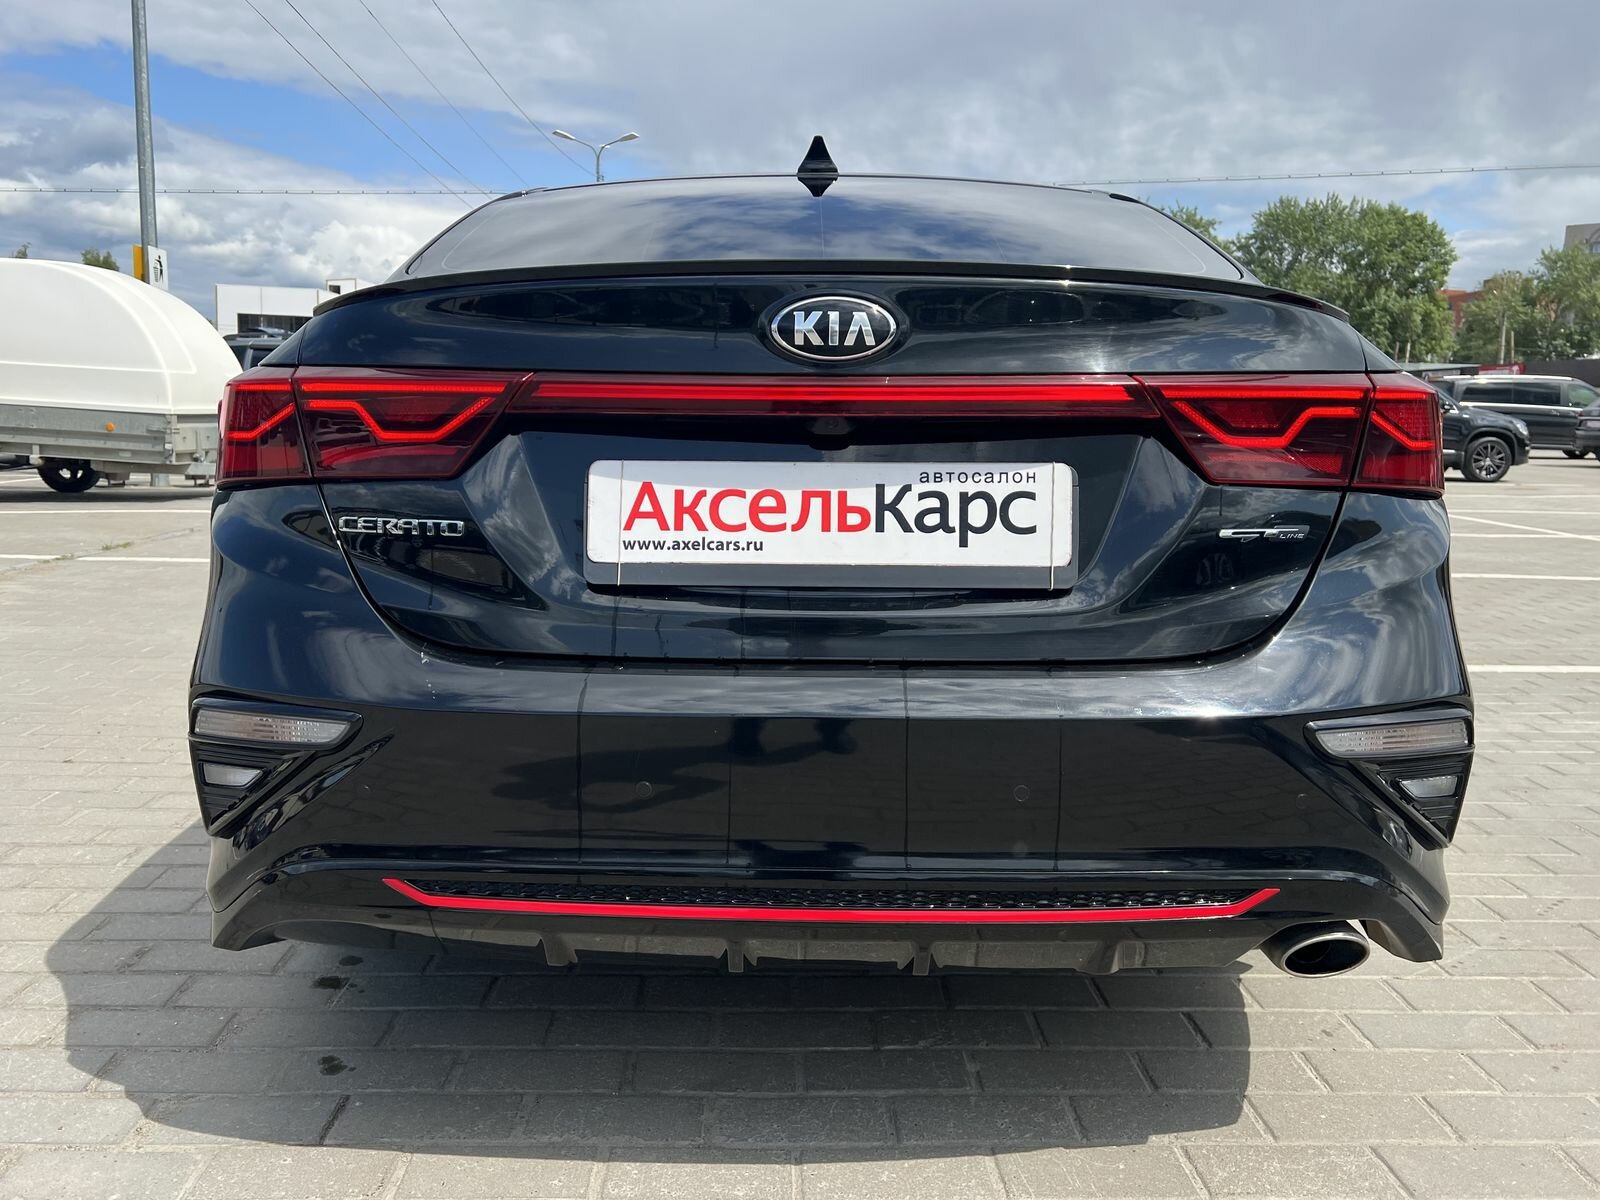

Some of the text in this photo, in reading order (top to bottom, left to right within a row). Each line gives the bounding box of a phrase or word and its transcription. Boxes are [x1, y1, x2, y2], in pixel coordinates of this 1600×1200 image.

[793, 311, 876, 346] KIA
[919, 471, 1036, 484] автосалон
[622, 481, 1037, 548] АксельКарс
[338, 516, 465, 537] CERATO
[622, 537, 764, 552] www.axelcars.ru
